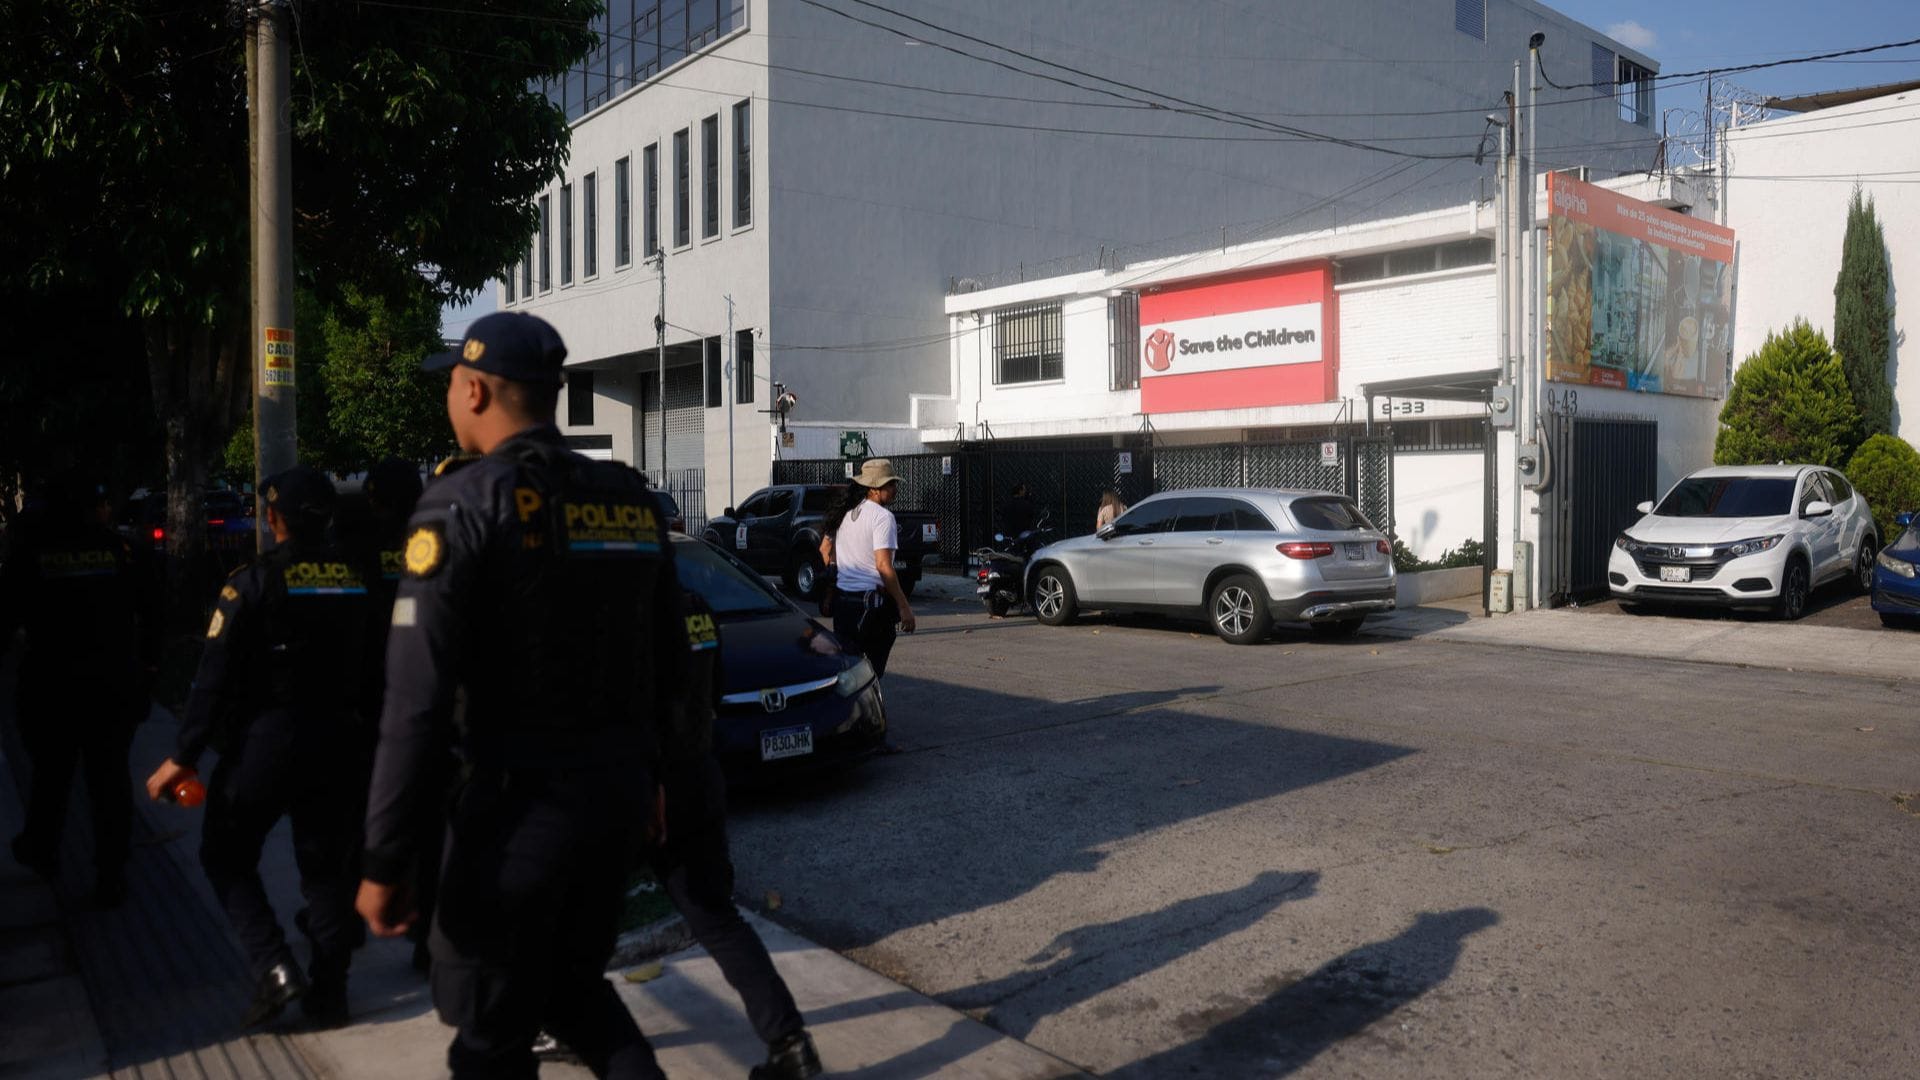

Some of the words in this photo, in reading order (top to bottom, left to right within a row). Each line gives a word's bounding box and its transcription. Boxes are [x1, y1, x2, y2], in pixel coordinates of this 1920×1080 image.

[1553, 187, 1587, 216] alpha
[267, 343, 293, 356] CASA
[1179, 339, 1214, 355] Save
[1216, 334, 1242, 351] the
[1244, 327, 1315, 348] Children
[1381, 401, 1425, 415] 9-33
[1548, 388, 1578, 415] 9-43
[565, 503, 656, 528] POLICIA
[764, 730, 811, 753] P830JHK
